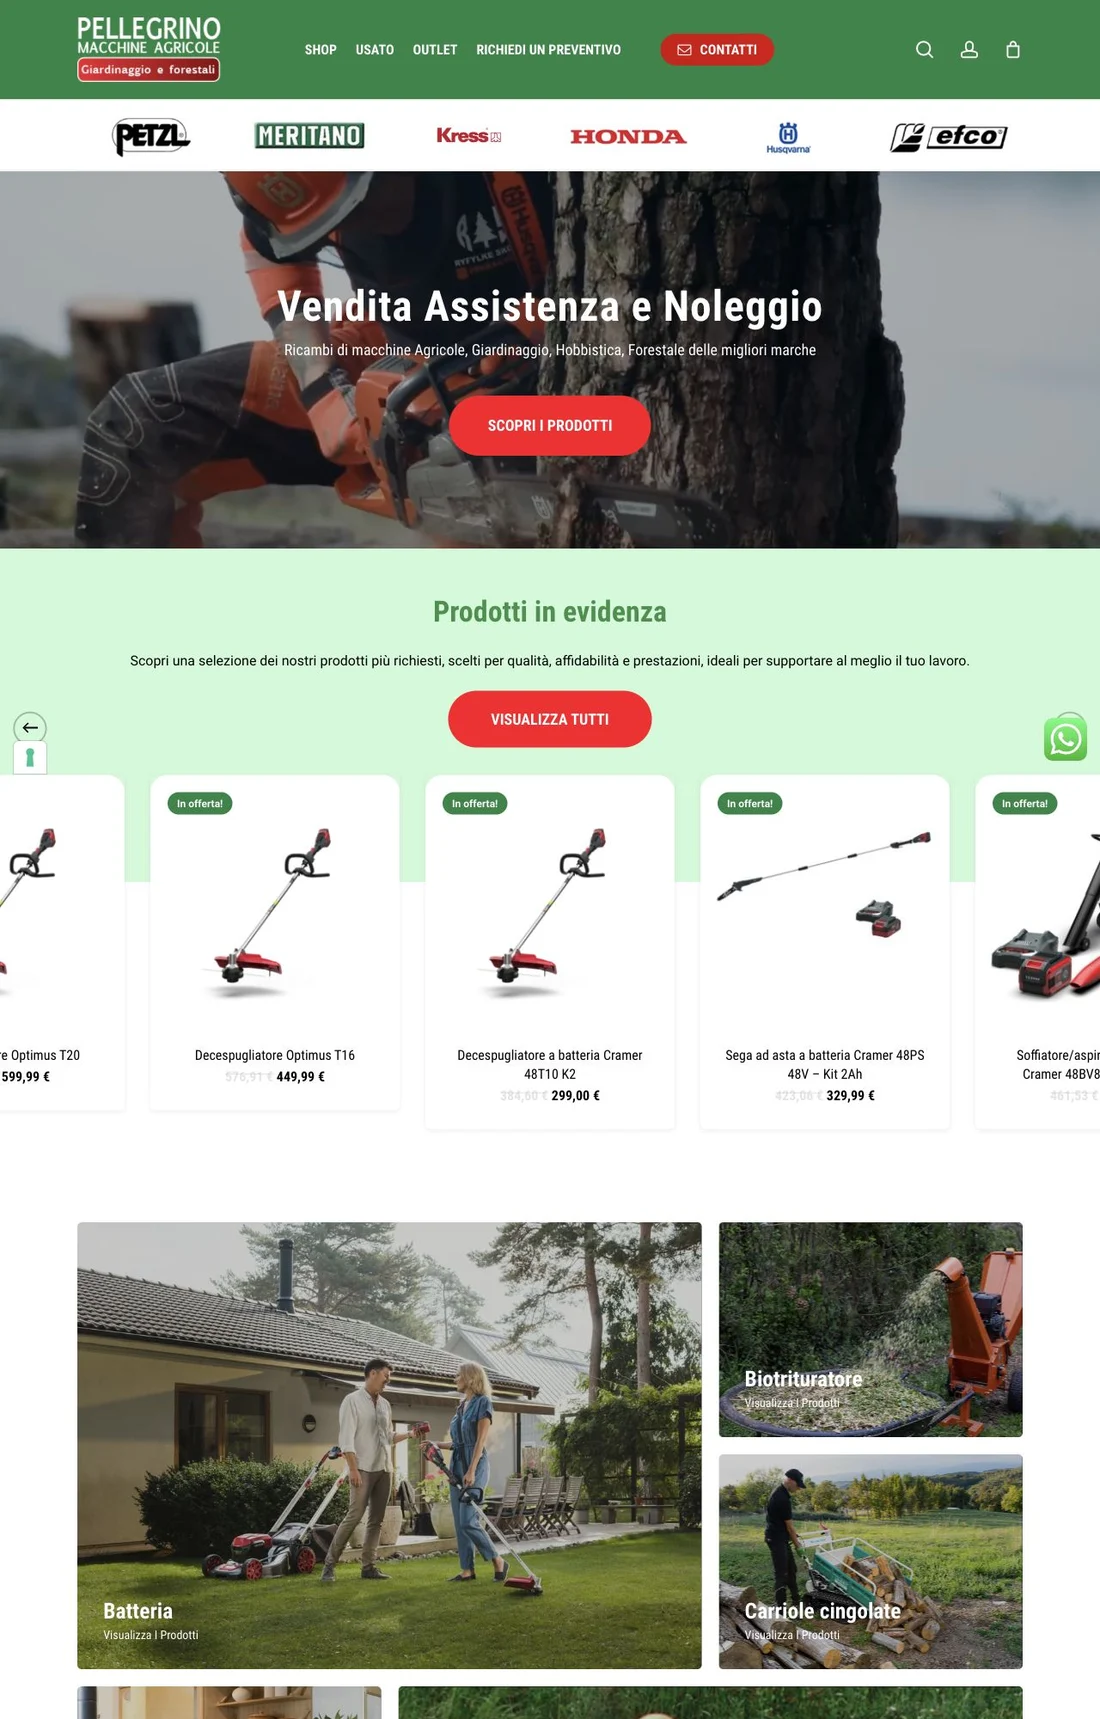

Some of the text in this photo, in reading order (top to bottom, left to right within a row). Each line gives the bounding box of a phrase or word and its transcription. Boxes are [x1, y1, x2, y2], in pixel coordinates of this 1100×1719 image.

[78, 17, 221, 40] PELLEGRINO
[77, 41, 220, 54] MACCHINE AGRICOLE
[305, 44, 337, 55] SHOP
[356, 44, 394, 55] USATO
[413, 44, 458, 55] OUTLET
[476, 44, 621, 55] RICHIEDI UN PREVENTIVO
[700, 44, 757, 55] CONTATTI
[81, 65, 151, 77] Giardinaggio
[169, 64, 215, 74] forestali
[117, 124, 190, 156] PETZL
[260, 126, 359, 145] MERITANO
[437, 128, 488, 142] Kress
[571, 130, 687, 144] HONDA
[937, 125, 997, 144] efco
[766, 145, 811, 155] Husqvarna
[277, 288, 822, 330] Vendita Assistenza e Noleggio
[284, 343, 816, 359] Ricambi di macchine Agricole, Giardinaggio, Hobbistica, Forestale delle migliori marche
[488, 419, 612, 432] SCOPRI I PRODOTTI
[434, 598, 667, 623] Prodotti in evidenza
[130, 654, 970, 669] Scopri una selezione dei nostri prodotti più richiesti, scelti per qualità, affidabilità e prestazioni, ideali per supportare al meglio il tuo lavoro.
[491, 713, 609, 726] VISUALIZZA TUTTI
[176, 798, 224, 808] In offerta!
[1001, 798, 1049, 808] In offerta!
[11, 1049, 57, 1064] Optimus
[59, 1049, 80, 1061] T20
[195, 1049, 355, 1064] Decespugliatore Optimus T16
[457, 1048, 643, 1064] Decespugliatore a batteria Cramer
[725, 1049, 925, 1064] Sega ad asta a batteria Cramer 48PS
[1, 1070, 50, 1085] 599,99 €
[276, 1070, 325, 1085] 449,99 €
[524, 1068, 576, 1080] 48T10 K2
[787, 1067, 863, 1080] 48V Kit 2Ah
[1022, 1068, 1062, 1080] Cramer
[551, 1089, 600, 1104] 299,00 €
[826, 1089, 875, 1104] 329,99 €
[745, 1370, 863, 1387] Biotrituratore
[104, 1603, 172, 1619] Batteria
[745, 1601, 901, 1623] Carriole cingolate
[104, 1630, 152, 1640] Visualizza
[160, 1630, 199, 1640] Prodotti
[745, 1630, 793, 1640] Visualizza
[801, 1630, 840, 1640] Prodotti
